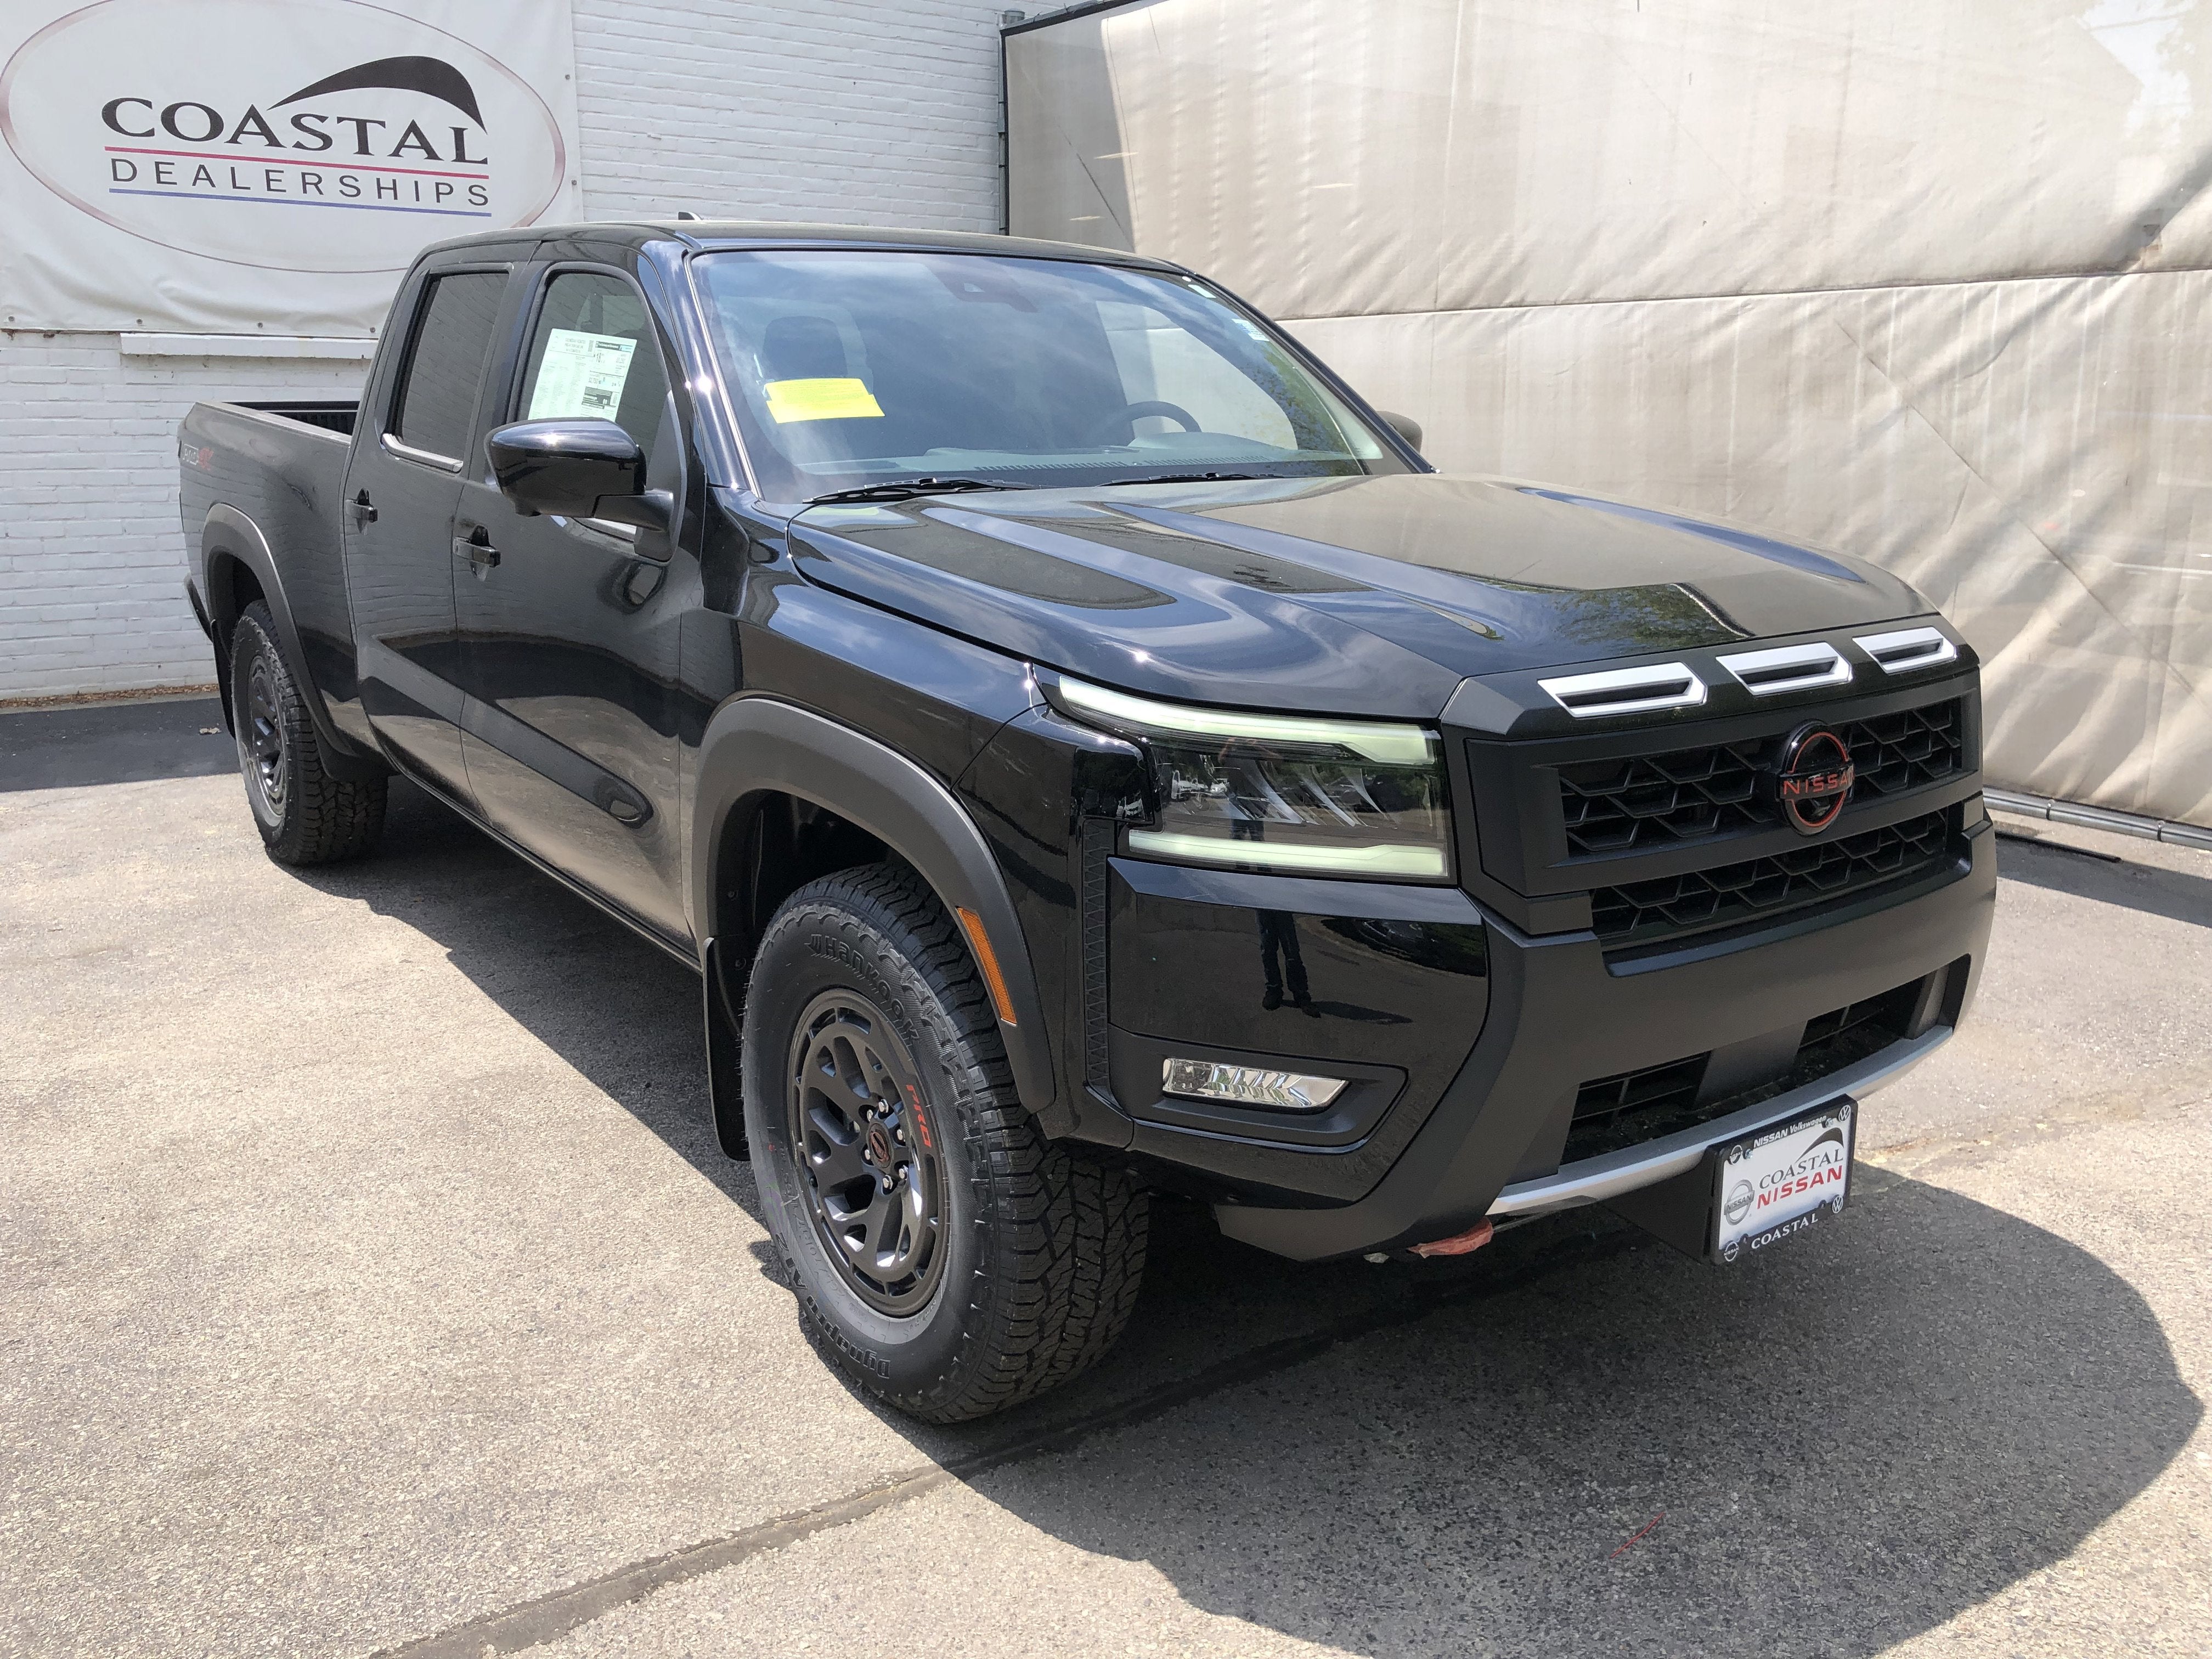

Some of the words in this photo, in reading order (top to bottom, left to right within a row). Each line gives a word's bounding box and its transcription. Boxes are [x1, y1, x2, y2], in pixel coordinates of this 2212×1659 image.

[101, 97, 488, 165] COASTAL
[111, 158, 489, 206] DEALERSHIPS
[1782, 771, 1855, 795] NISSAN
[1753, 1128, 1788, 1148] NISSAN
[1790, 1115, 1827, 1134] Volkswagen
[1757, 1165, 1843, 1210] NISSAN
[1759, 1148, 1844, 1189] COASTAL
[1726, 1193, 1752, 1210] NISSAN
[1751, 1213, 1819, 1249] COASTAL
[806, 1294, 891, 1379] Dynapro
